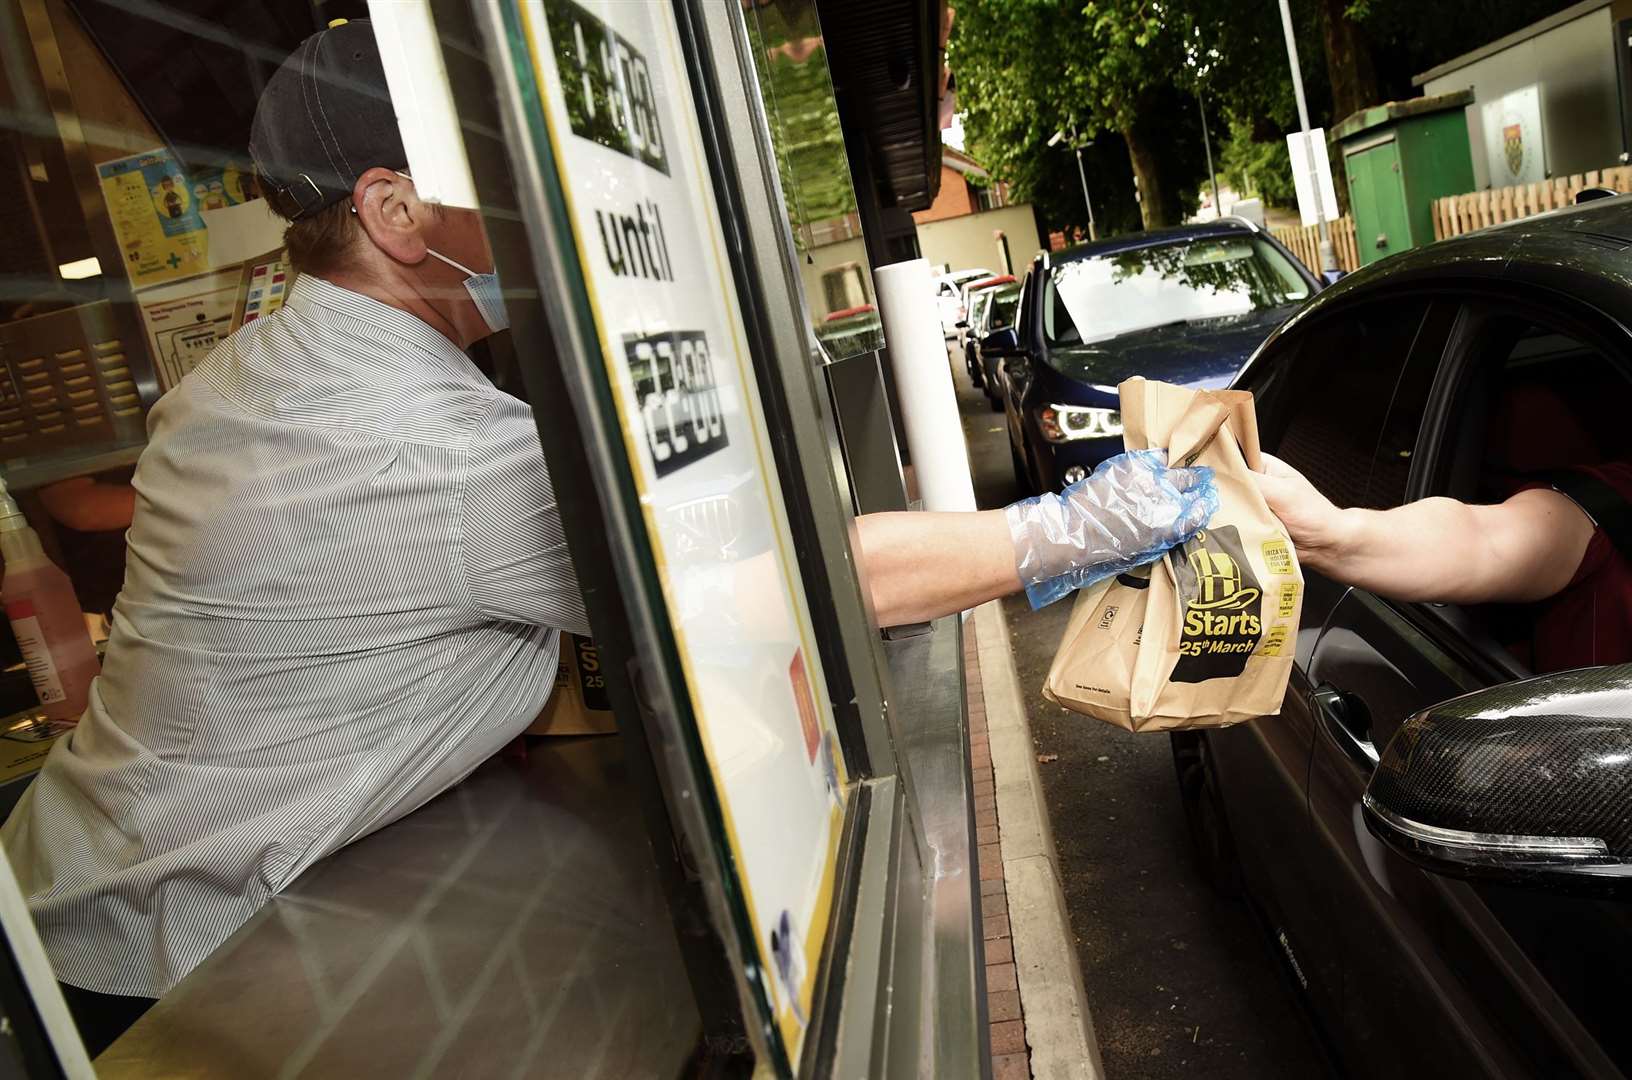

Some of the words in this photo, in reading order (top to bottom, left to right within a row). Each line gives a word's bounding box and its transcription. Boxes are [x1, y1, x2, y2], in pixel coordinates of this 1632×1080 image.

[595, 198, 674, 282] until
[634, 340, 722, 462] 22:00
[1180, 640, 1210, 657] 25th
[1208, 640, 1255, 653] March
[1184, 609, 1261, 636] Starts
